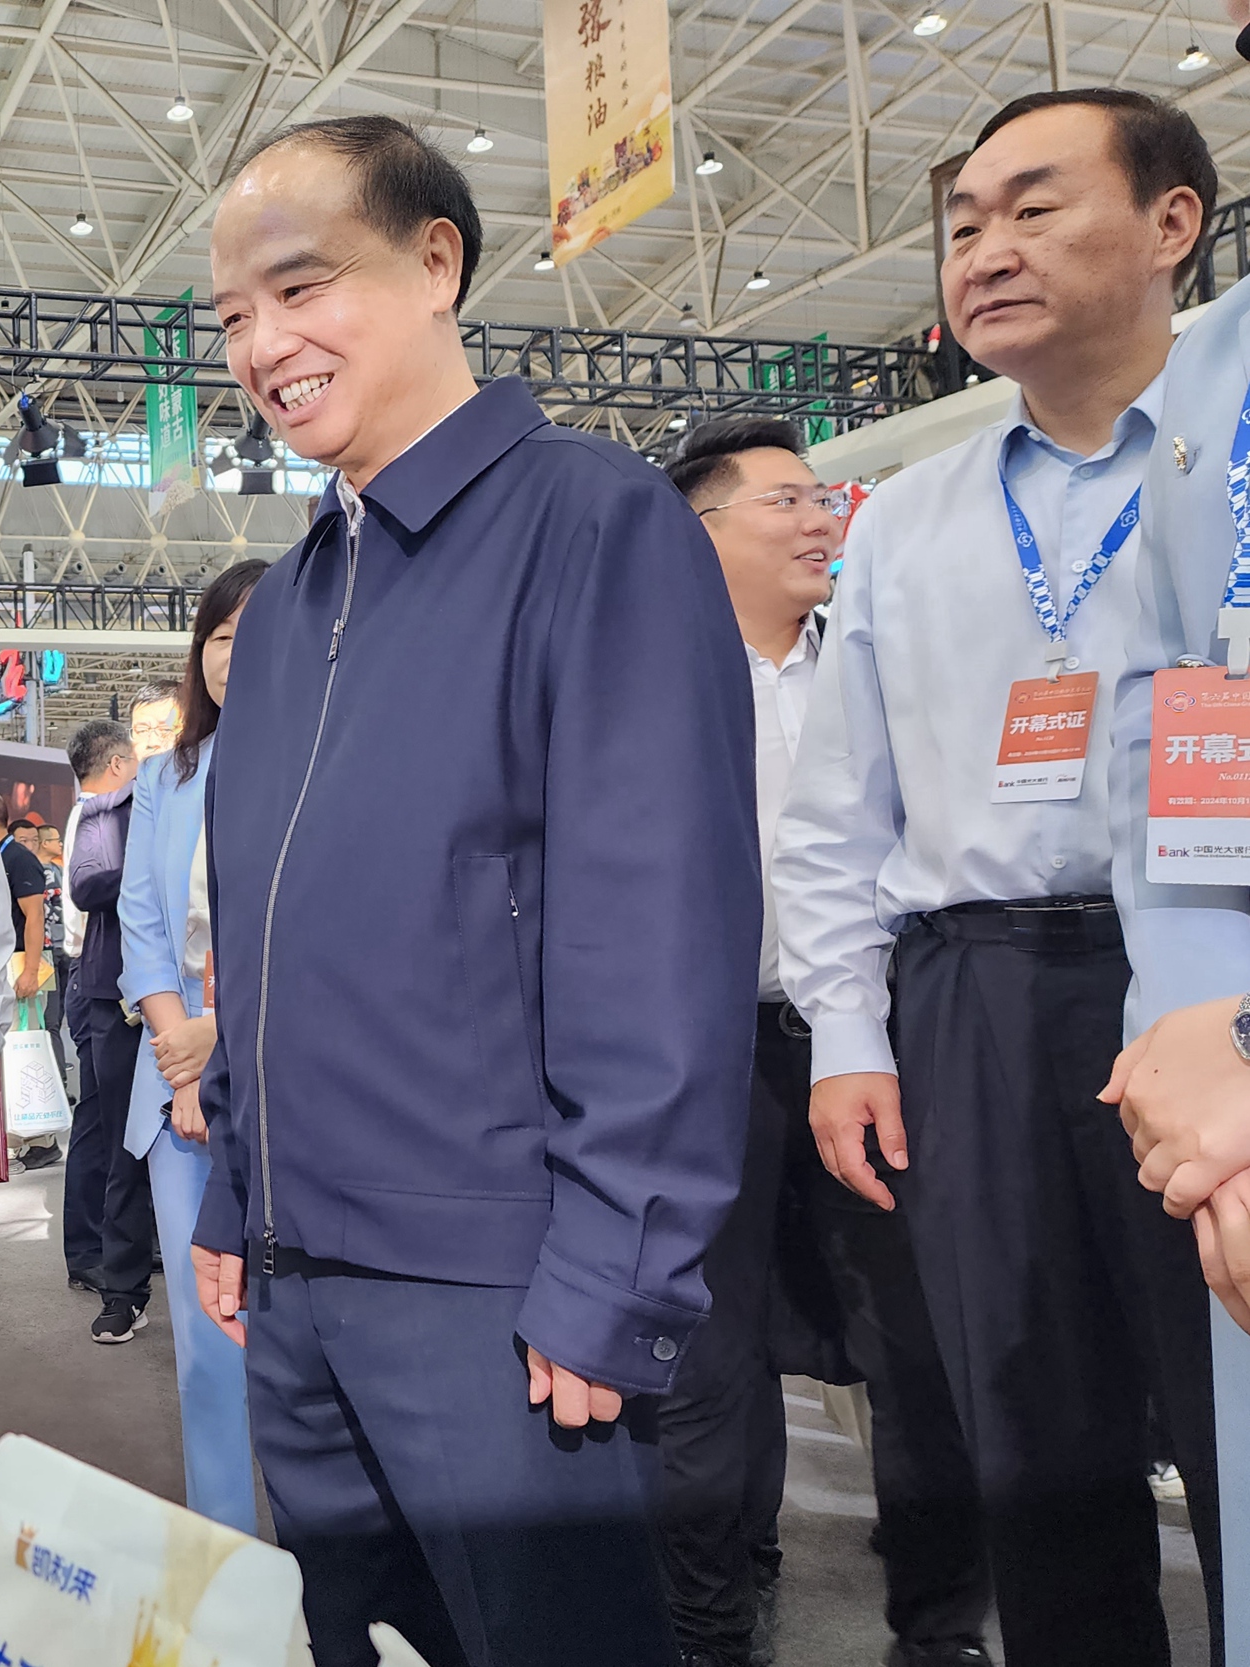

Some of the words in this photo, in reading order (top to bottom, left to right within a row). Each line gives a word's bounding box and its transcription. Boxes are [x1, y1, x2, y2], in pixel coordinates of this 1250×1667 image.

[1009, 710, 1088, 735] 开幕式证
[1158, 845, 1190, 857] Bank
